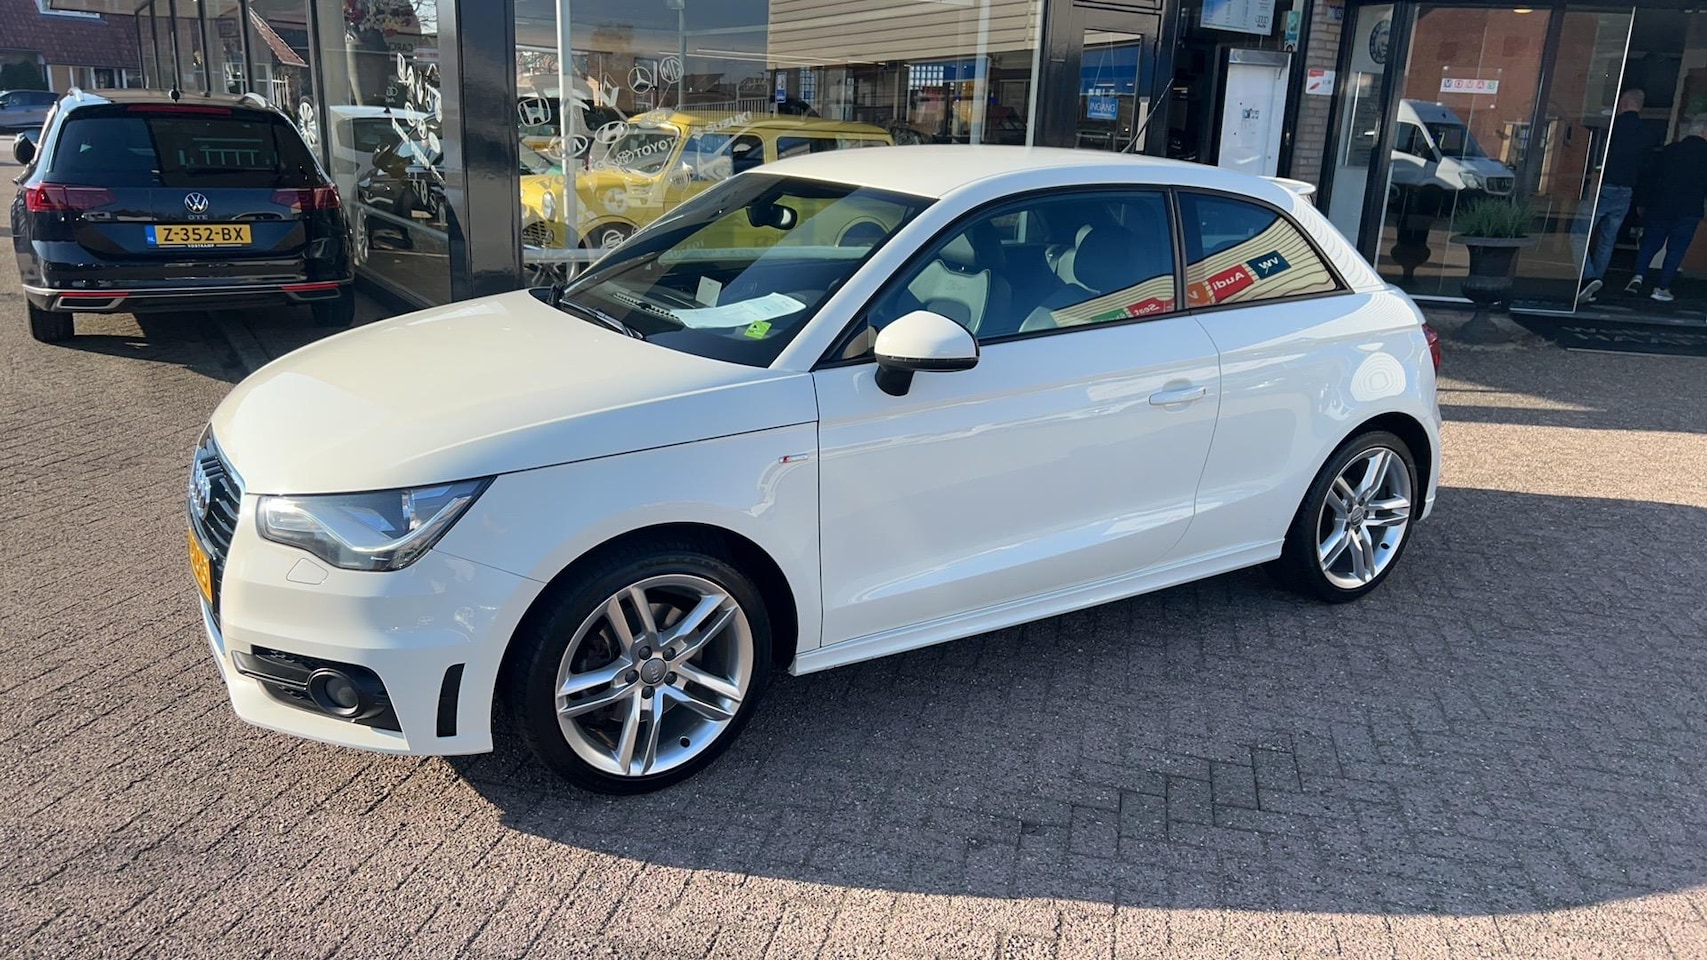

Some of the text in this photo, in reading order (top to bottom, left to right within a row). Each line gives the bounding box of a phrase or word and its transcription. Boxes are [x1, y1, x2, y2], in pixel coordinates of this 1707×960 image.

[662, 58, 682, 81] MG
[1090, 102, 1116, 112] INGANG
[634, 137, 675, 159] TOYOT
[163, 227, 244, 242] Z-352-BX
